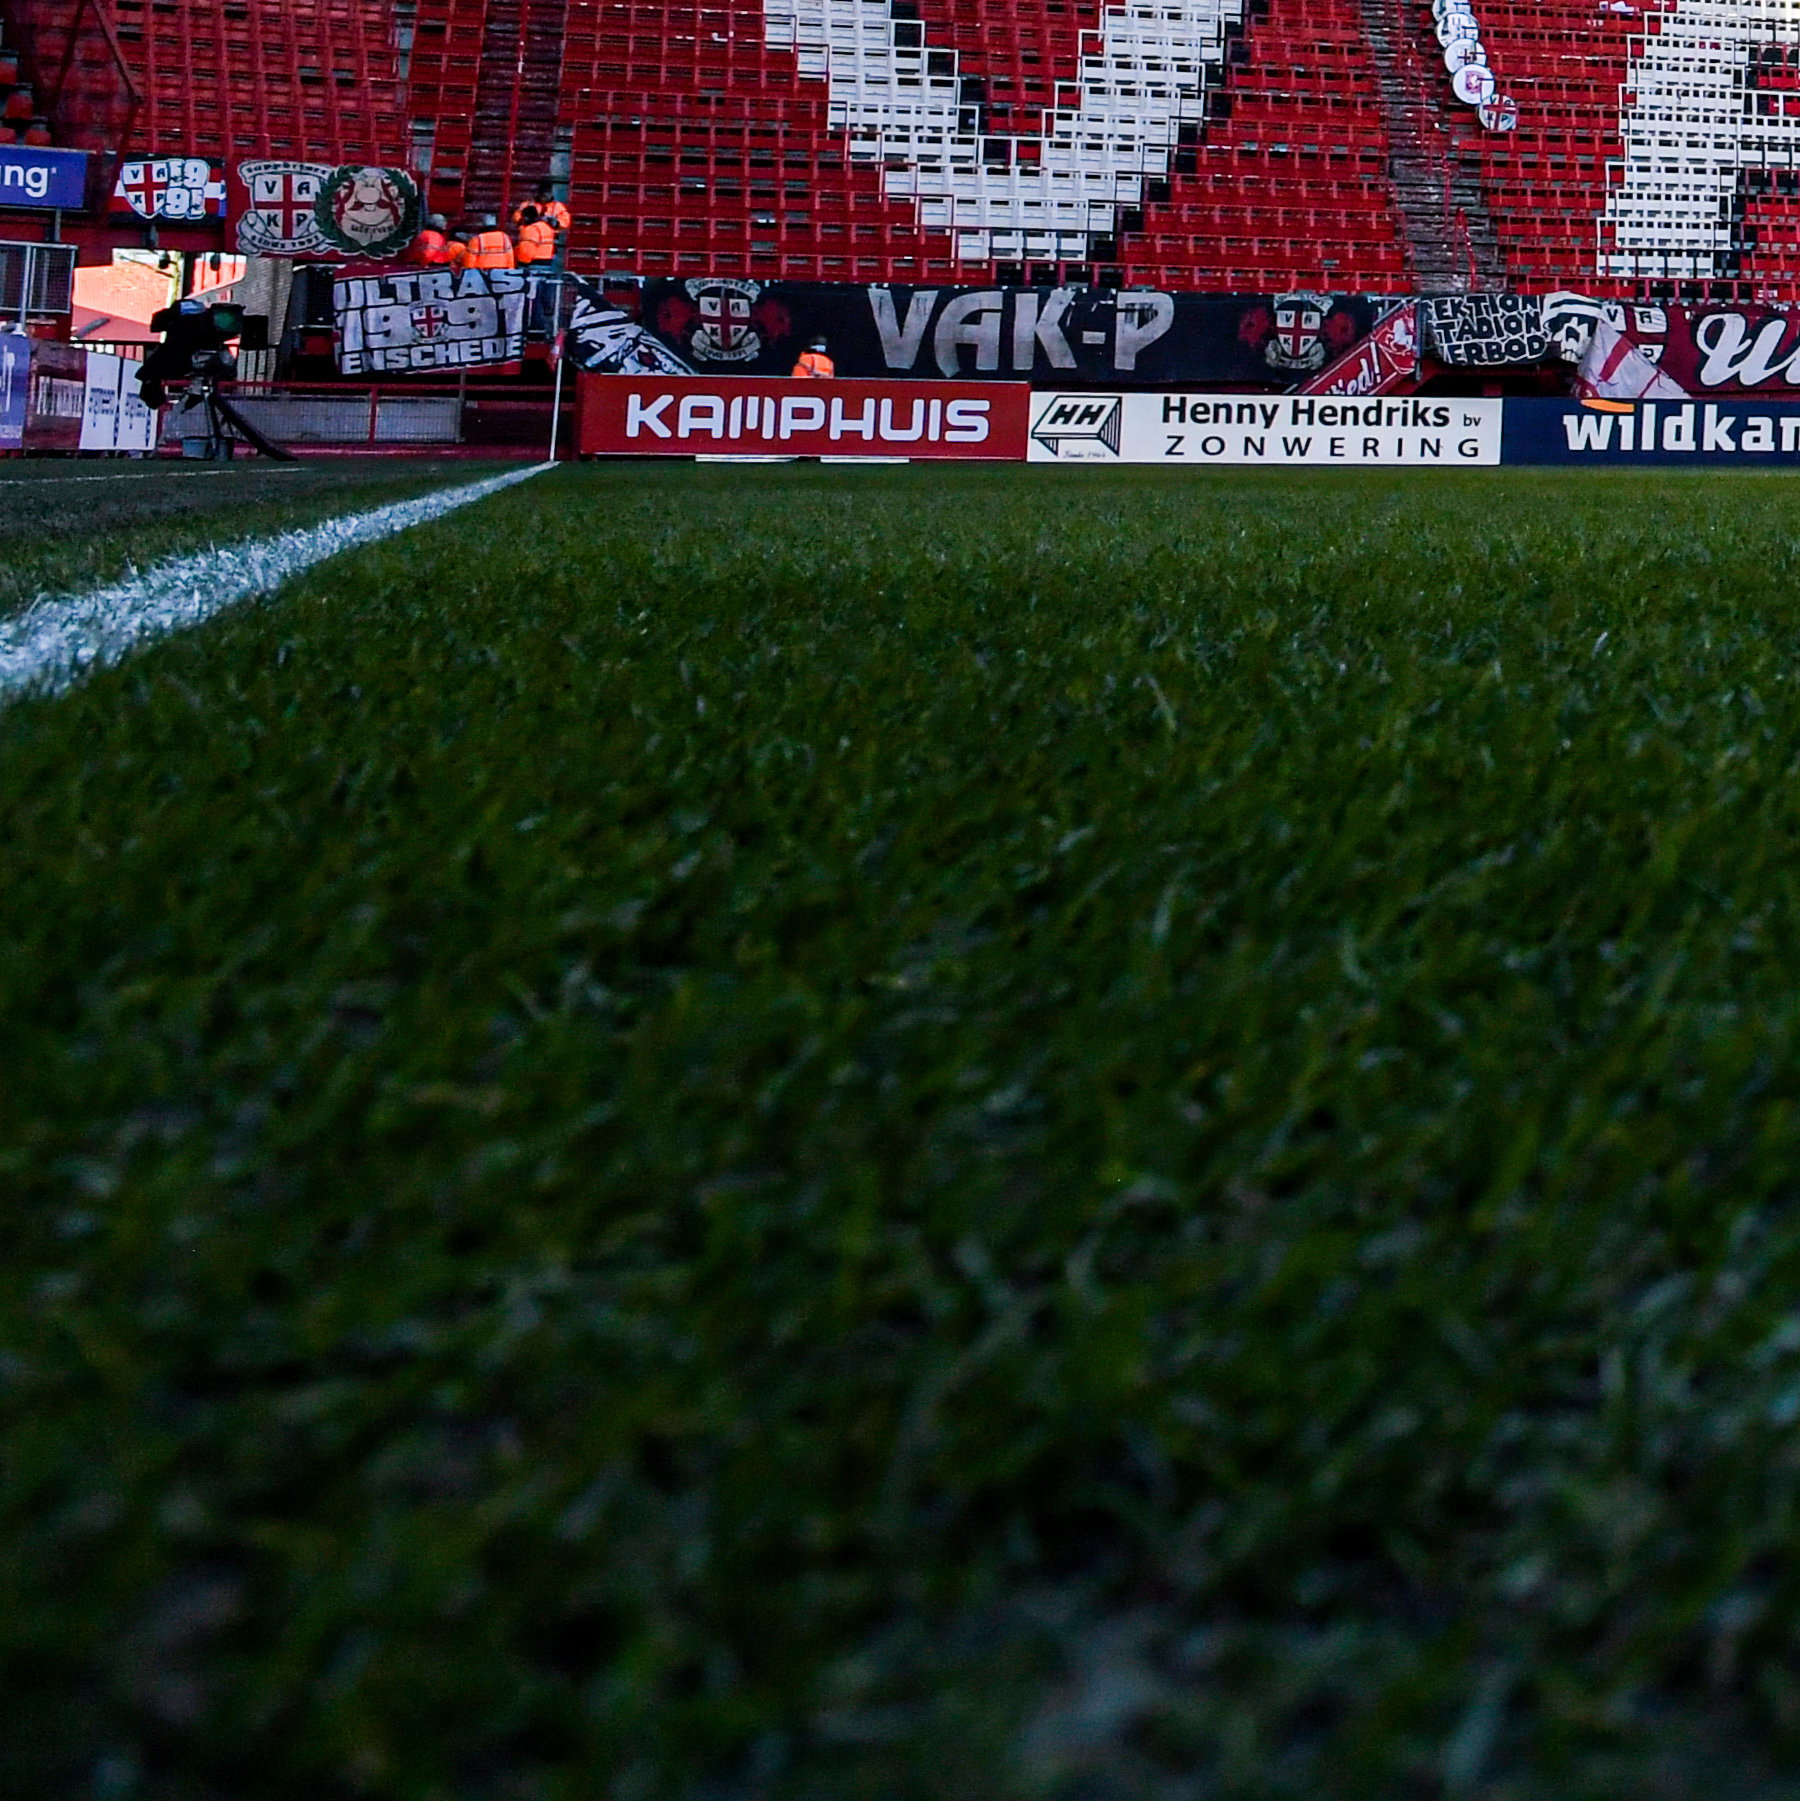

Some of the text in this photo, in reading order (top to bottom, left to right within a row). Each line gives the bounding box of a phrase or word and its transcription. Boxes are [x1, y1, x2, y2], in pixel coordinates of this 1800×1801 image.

[333, 269, 525, 310] ULTRAS
[868, 288, 1174, 377] VAK-P
[1432, 311, 1546, 344] TADION
[341, 334, 524, 375] ENSCHEDE
[1444, 334, 1549, 364] ERBOD
[626, 394, 990, 442] KAMPHUIS
[1049, 403, 1108, 426] HH
[1162, 396, 1482, 429] Henny Hendriks bv
[1165, 435, 1480, 458] ZONWERING
